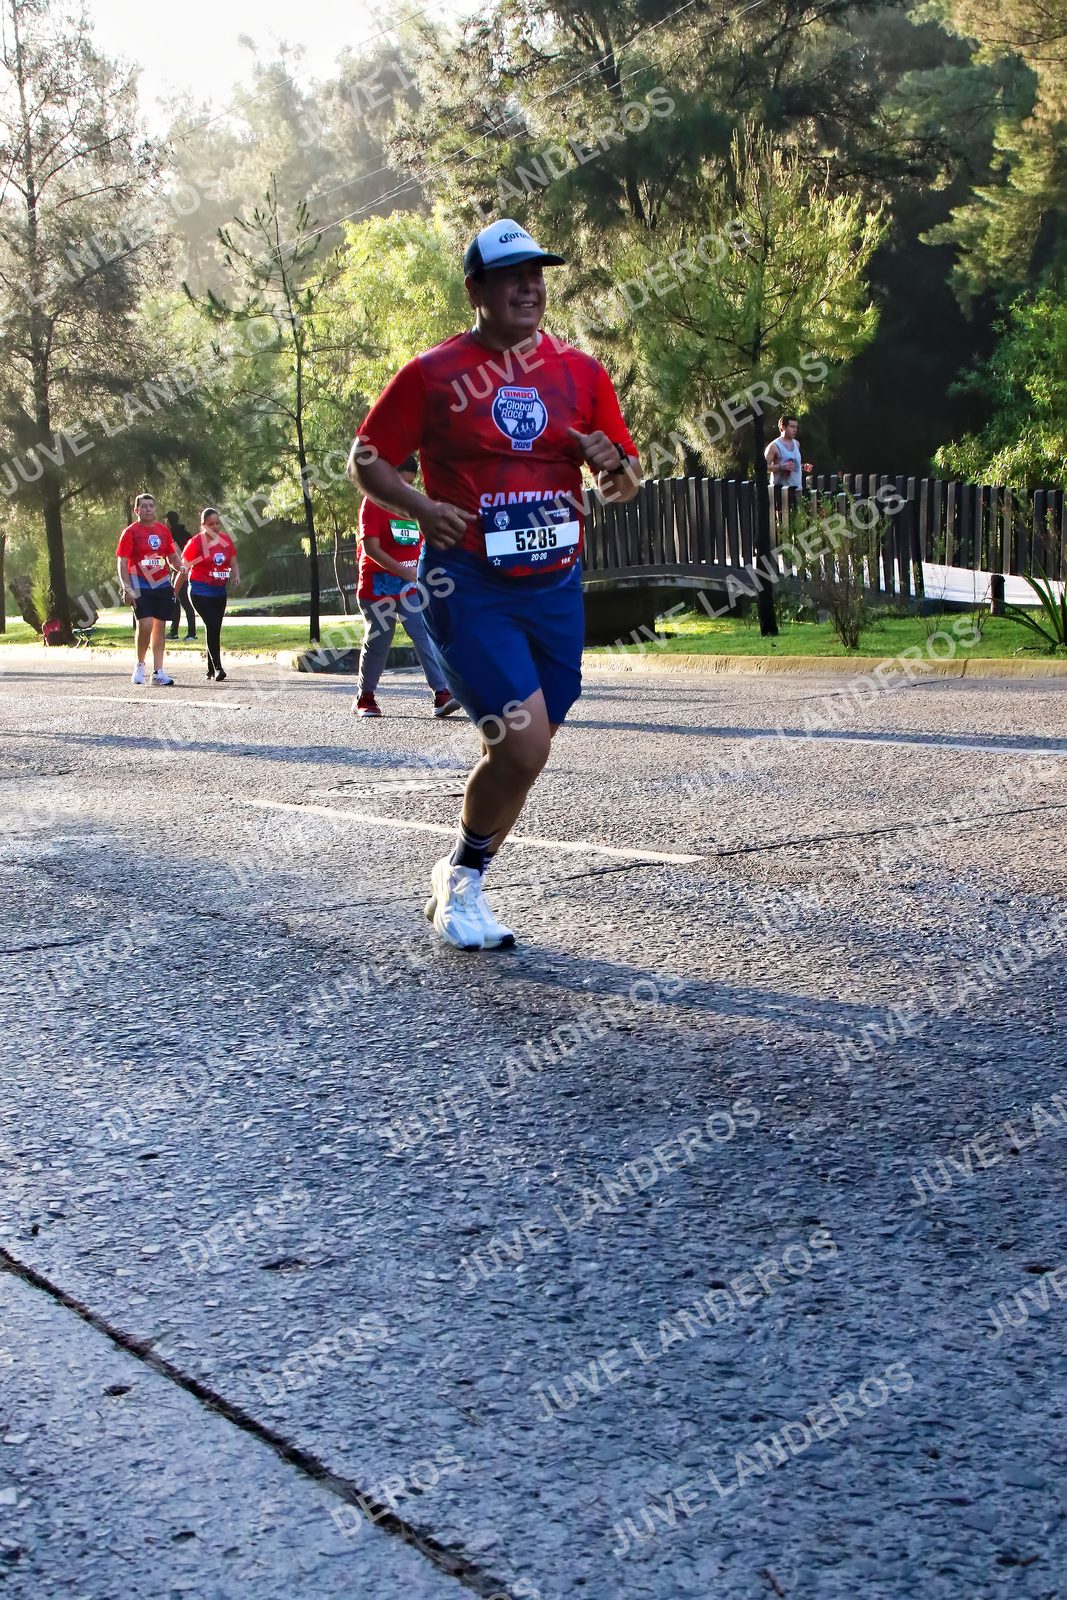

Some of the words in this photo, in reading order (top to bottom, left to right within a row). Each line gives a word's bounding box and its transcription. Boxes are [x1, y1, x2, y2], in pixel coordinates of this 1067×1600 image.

[506, 400, 534, 412] Global
[501, 407, 523, 419] Race
[513, 441, 531, 449] 2026
[400, 529, 409, 537] 413
[515, 527, 557, 551] 5285
